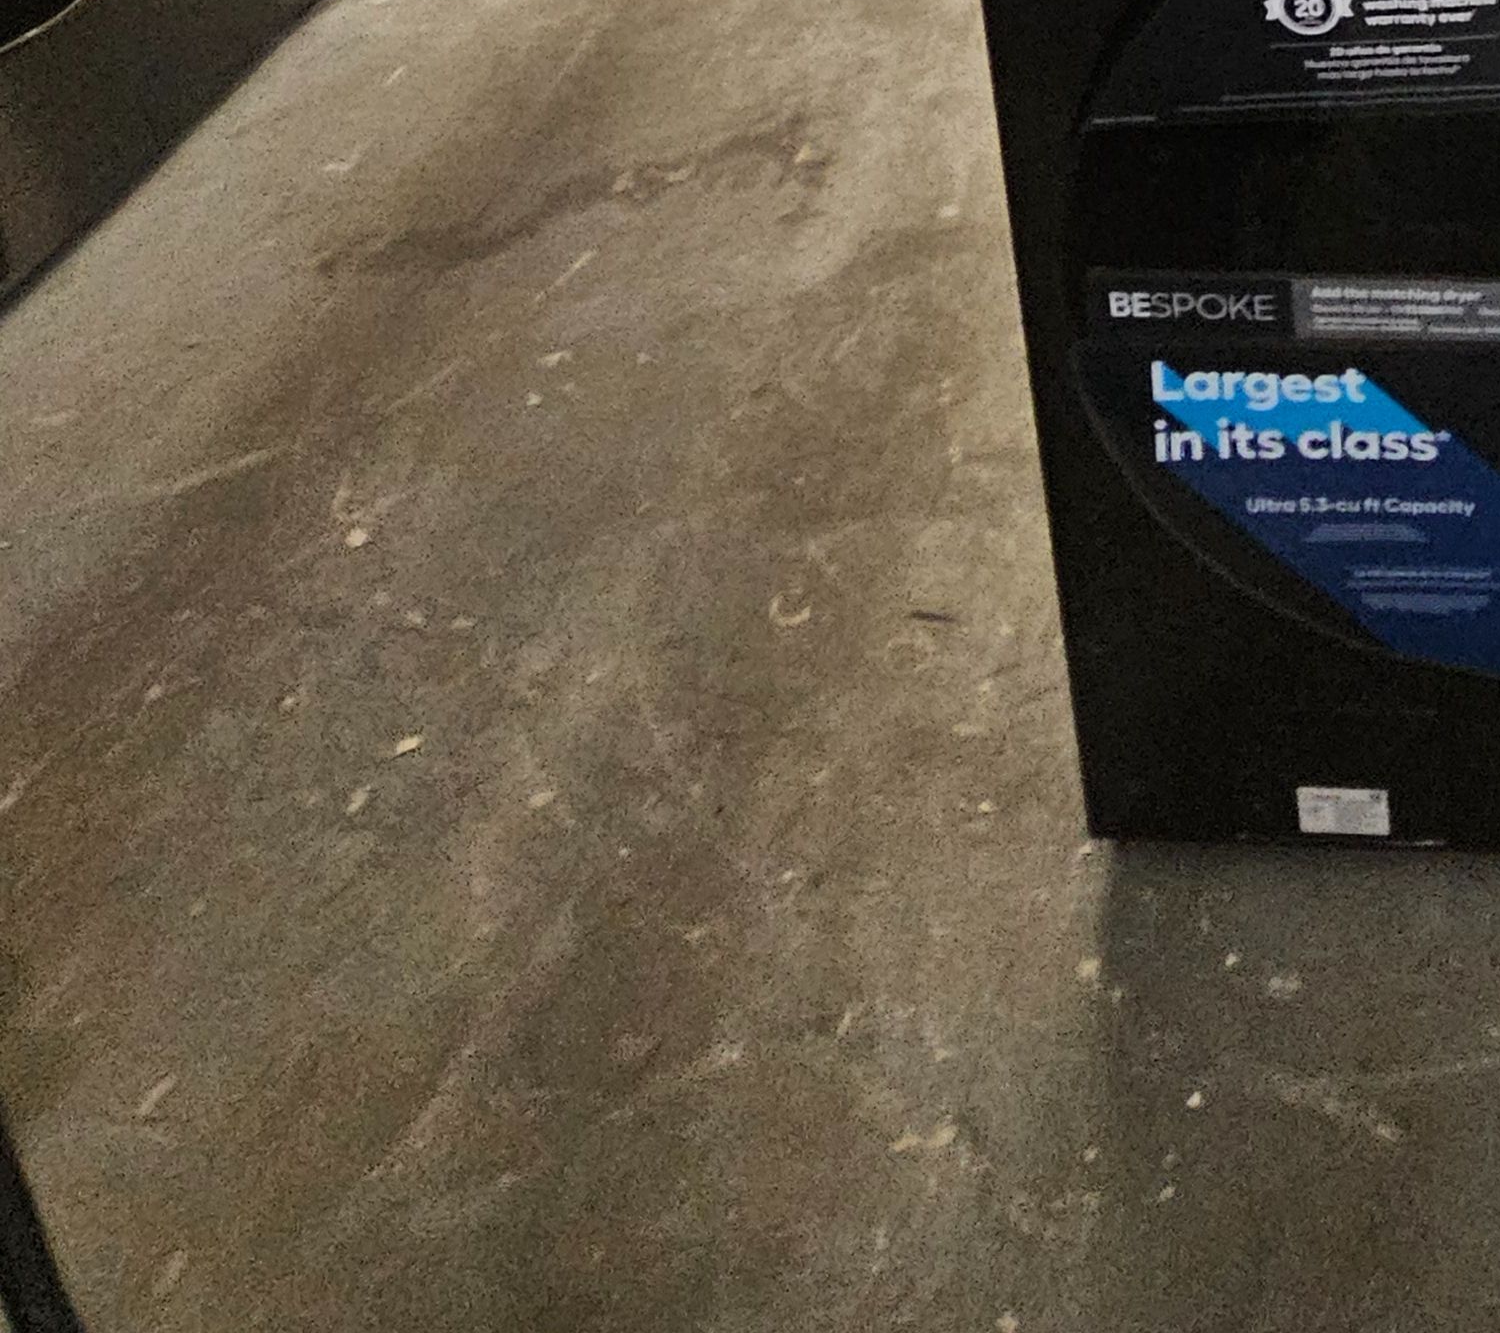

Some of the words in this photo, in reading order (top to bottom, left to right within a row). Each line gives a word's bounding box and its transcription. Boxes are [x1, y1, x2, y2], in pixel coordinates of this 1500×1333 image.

[1108, 290, 1278, 322] BESPOKE
[1150, 359, 1368, 412] Largest
[1153, 418, 1203, 463] in
[1216, 416, 1285, 461] its
[1244, 496, 1297, 515] Ultra
[1362, 497, 1382, 514] ft
[1383, 497, 1477, 518] Capacity
